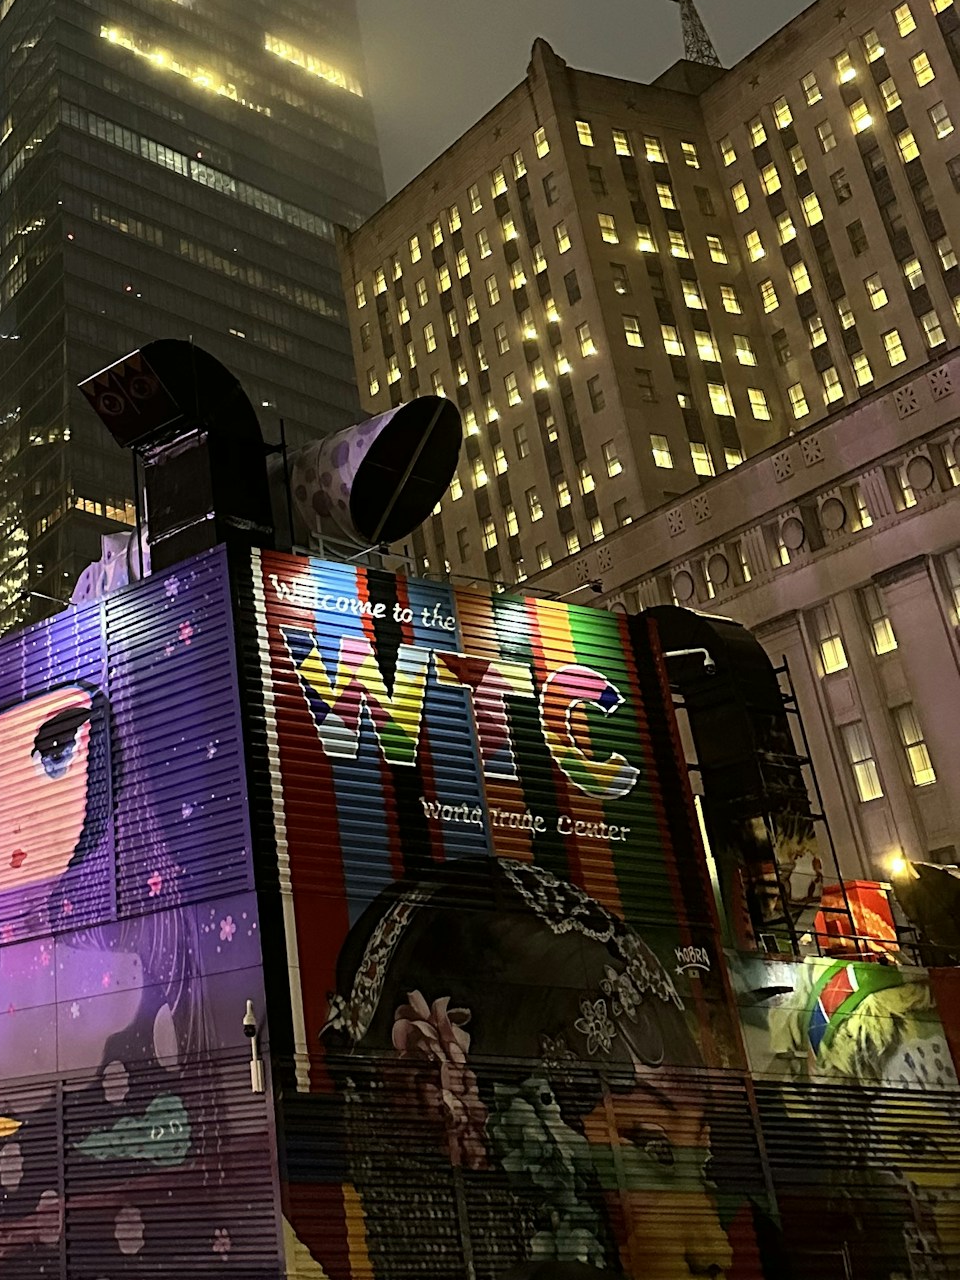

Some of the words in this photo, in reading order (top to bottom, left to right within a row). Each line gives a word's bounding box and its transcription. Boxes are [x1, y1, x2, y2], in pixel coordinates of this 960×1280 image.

[268, 573, 387, 619] Wcome
[393, 602, 414, 623] to
[421, 602, 456, 631] the
[280, 624, 640, 800] WTC
[419, 796, 484, 832] World
[488, 806, 547, 839] Trade
[556, 815, 631, 842] Center
[673, 946, 711, 966] KOBRA
